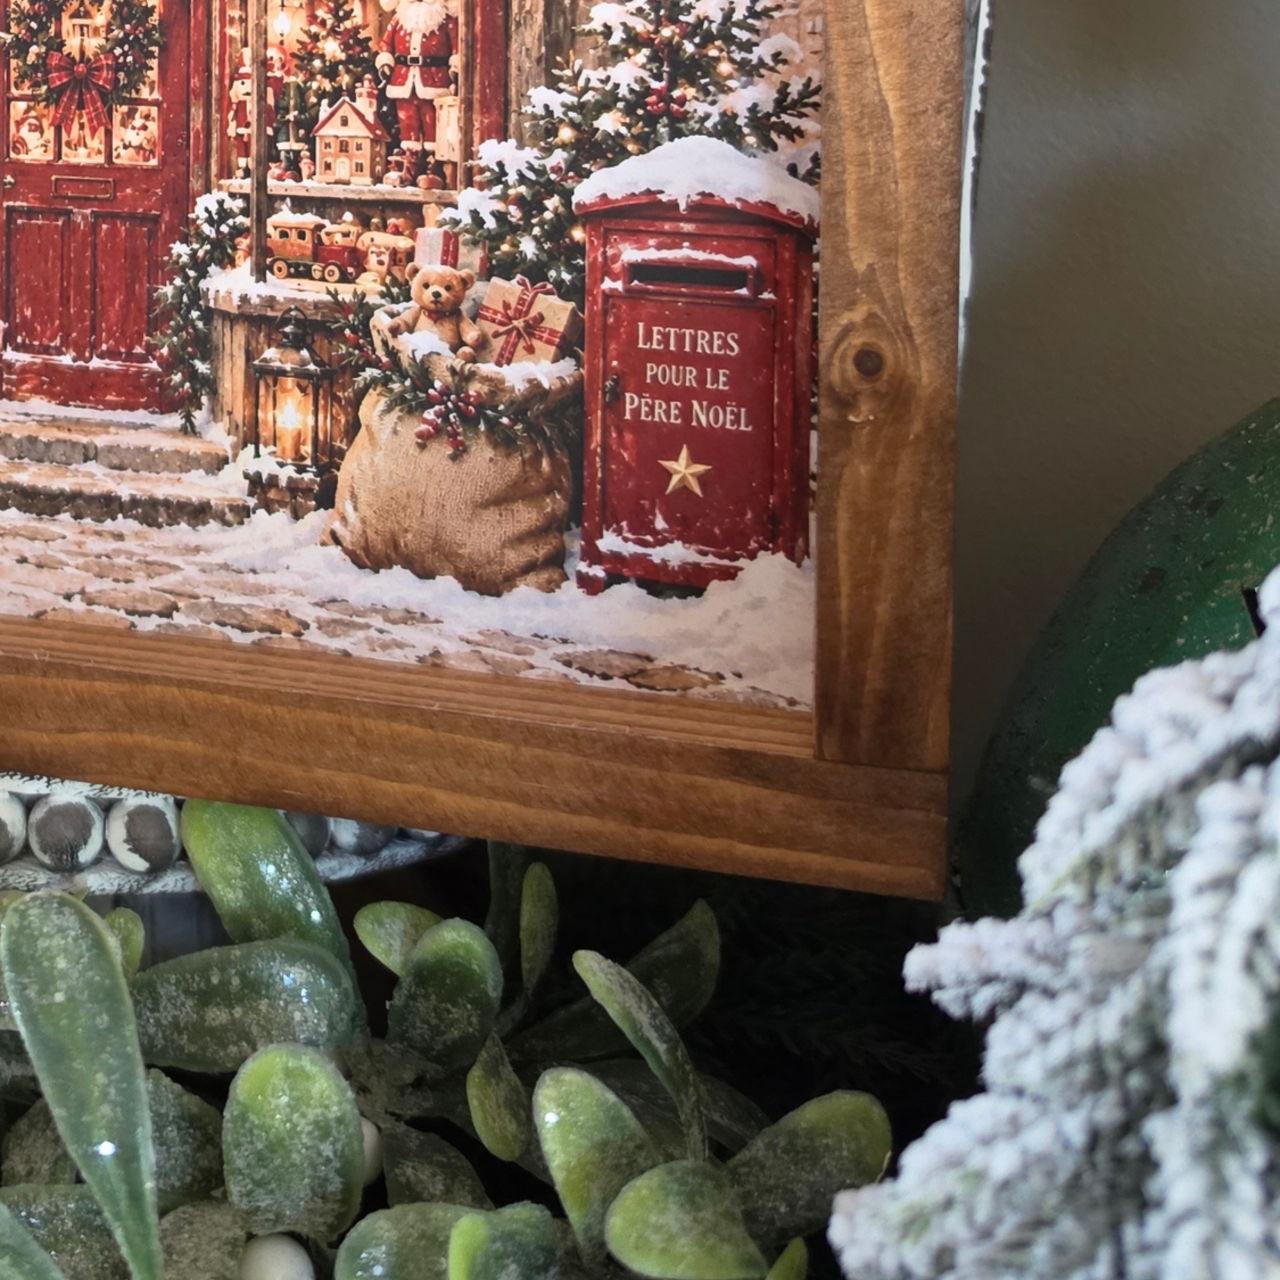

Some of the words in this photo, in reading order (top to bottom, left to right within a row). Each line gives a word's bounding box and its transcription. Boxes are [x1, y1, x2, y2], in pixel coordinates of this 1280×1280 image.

[637, 322, 739, 356] LETTRES
[645, 363, 697, 388] POUR
[706, 368, 730, 390] LE
[691, 400, 753, 431] NOËL
